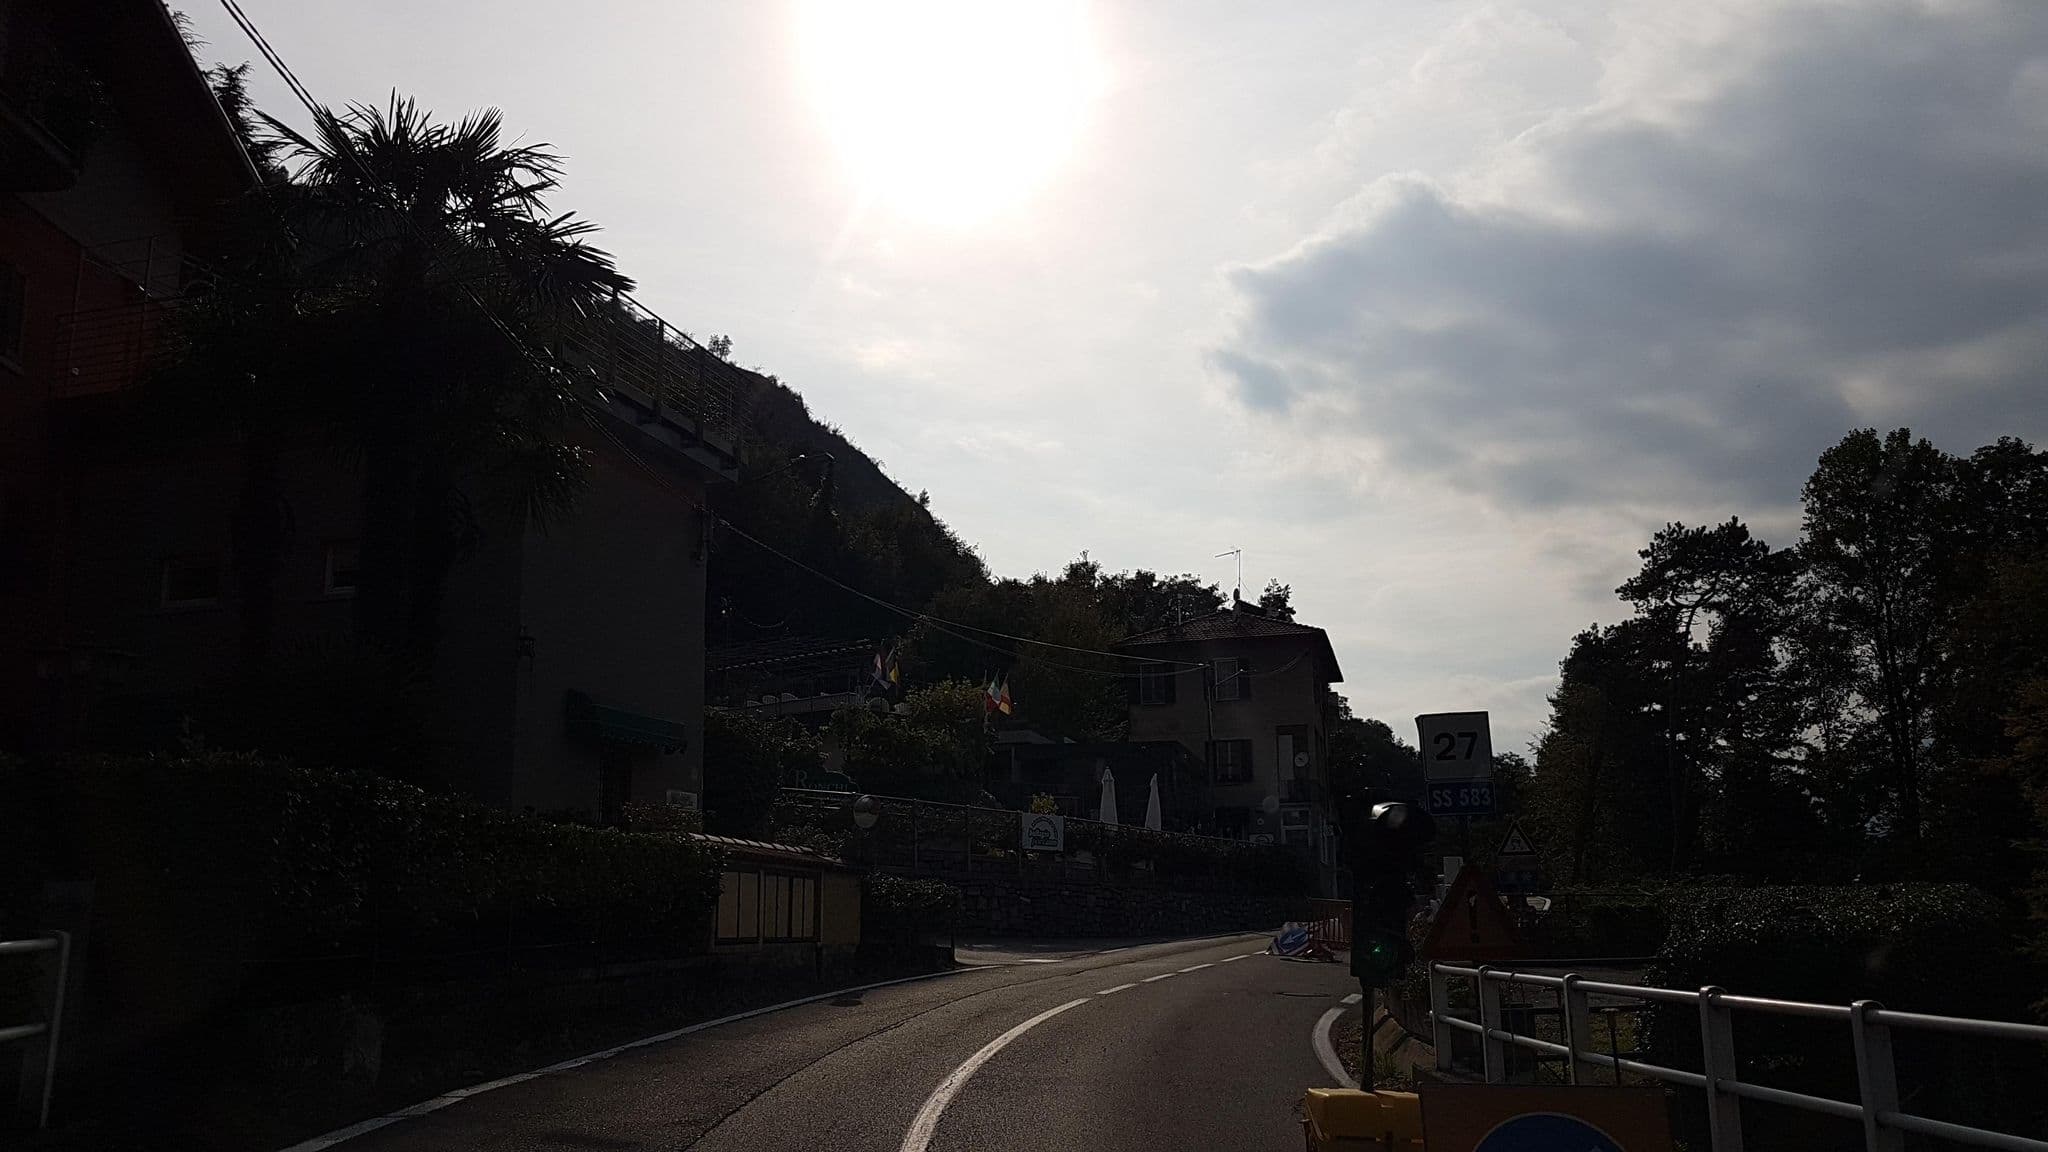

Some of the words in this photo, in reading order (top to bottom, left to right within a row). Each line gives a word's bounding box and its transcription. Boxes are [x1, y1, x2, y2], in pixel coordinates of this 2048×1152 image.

[1433, 731, 1478, 761] 27
[1432, 789, 1453, 808] SS
[1459, 787, 1491, 807] 583
